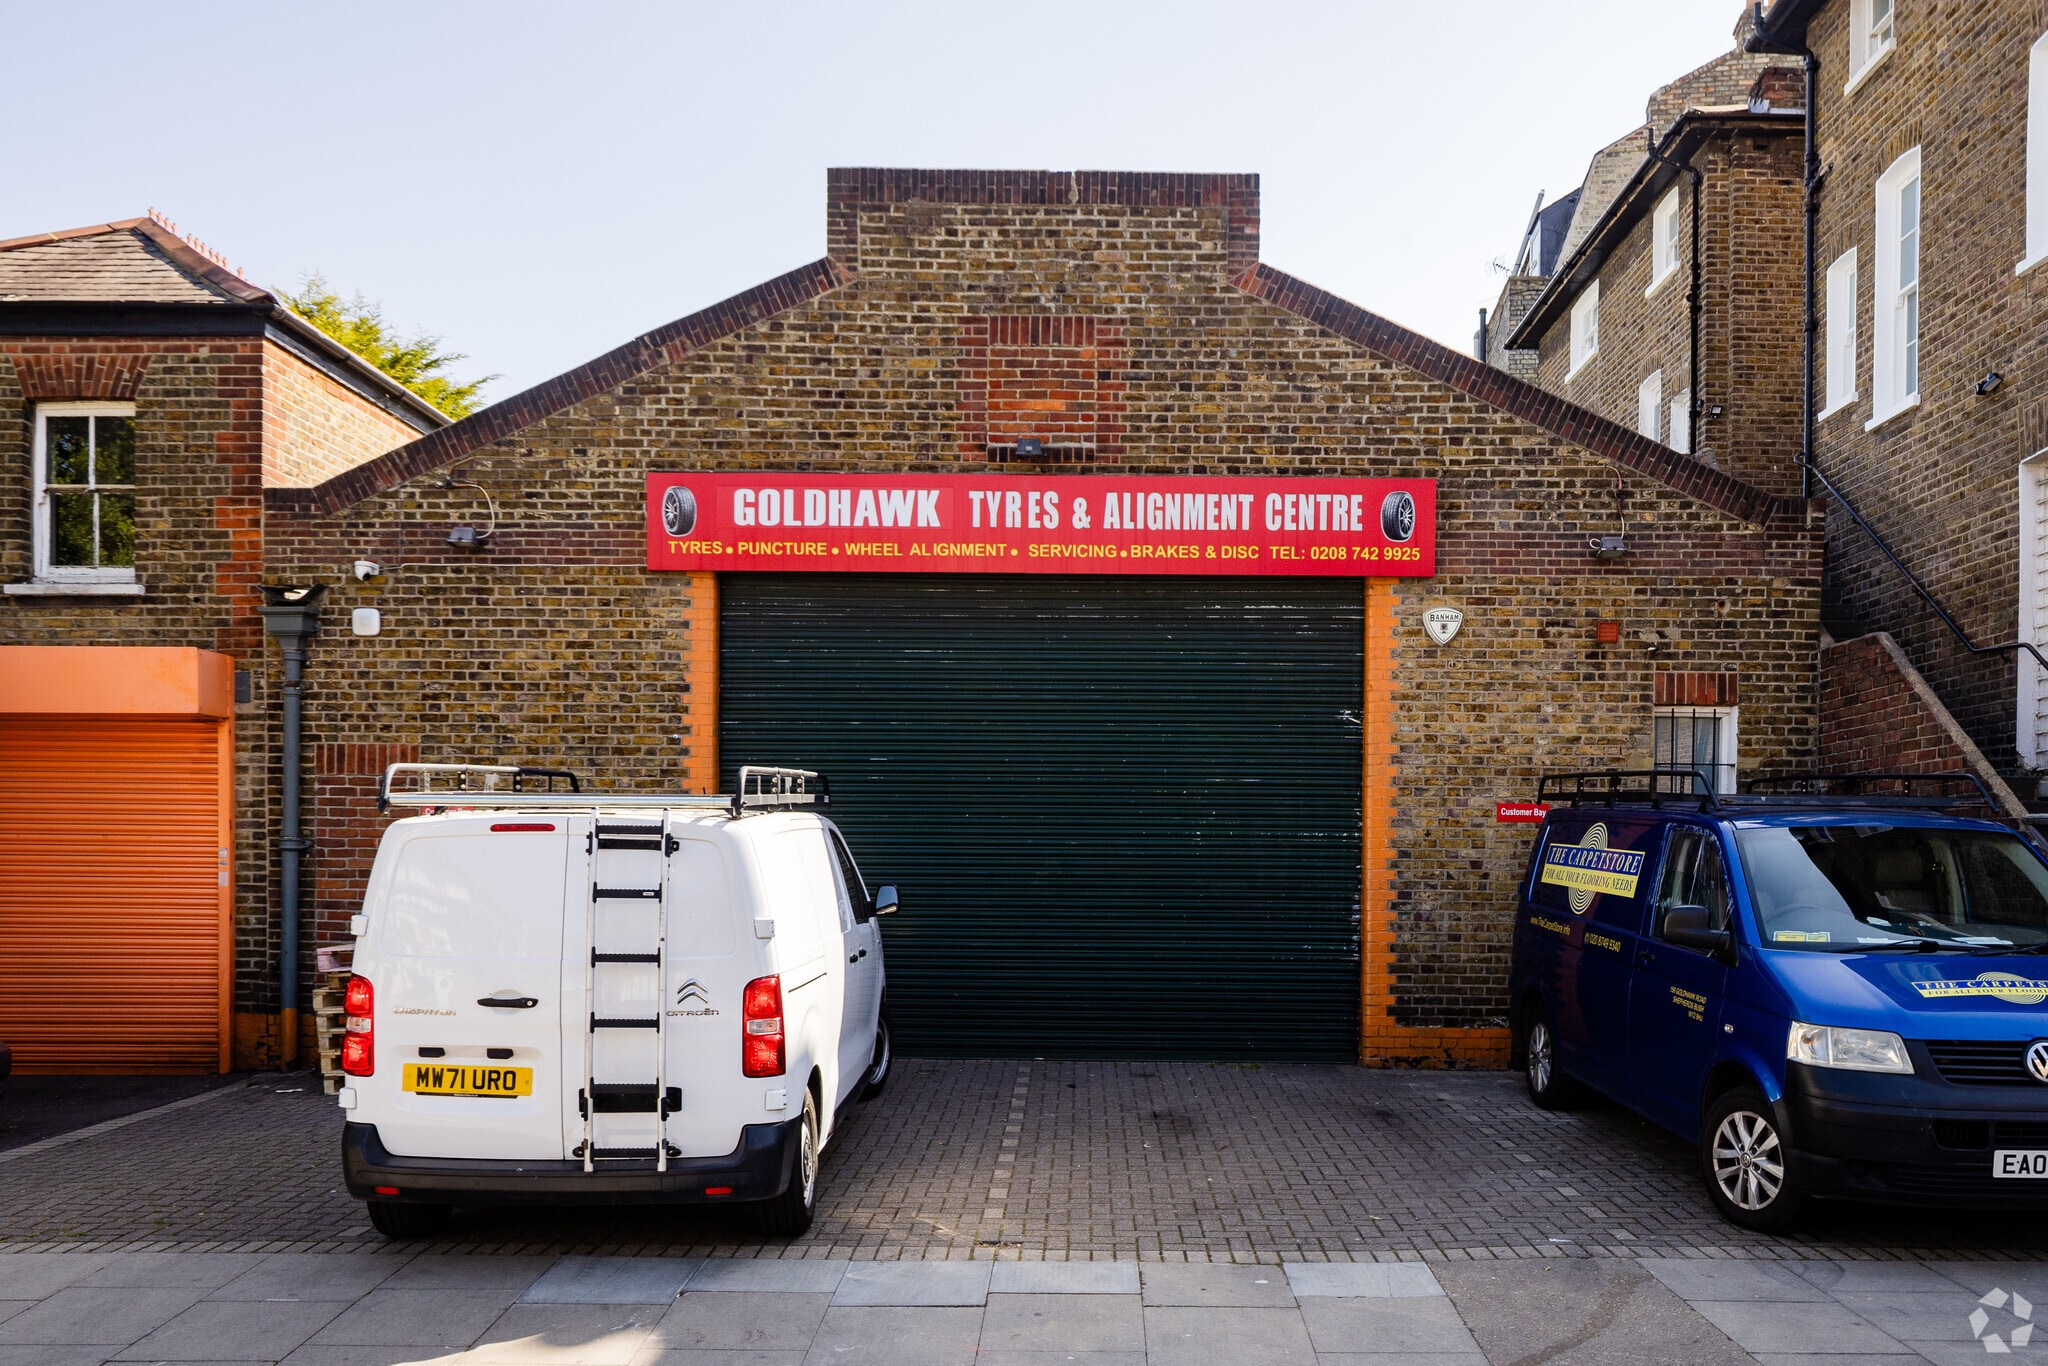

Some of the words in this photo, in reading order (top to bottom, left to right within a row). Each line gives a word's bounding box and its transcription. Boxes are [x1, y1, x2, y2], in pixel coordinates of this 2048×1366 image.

[733, 488, 941, 528] GOLDHAWK
[968, 490, 1060, 530] TYRES
[1072, 497, 1091, 529] &
[1103, 491, 1255, 531] ALIGNMENT
[1265, 492, 1363, 532] CENTRE
[668, 540, 723, 555] TYRES
[738, 541, 828, 556] PUNCTURE
[844, 542, 904, 556] WHEEL
[909, 542, 1007, 557] ALIGNMENT
[1028, 543, 1117, 558] SERVICING
[1130, 544, 1200, 559] BRAKES
[1205, 545, 1217, 559] &
[1221, 545, 1259, 559] DISC
[1269, 545, 1305, 560] TEL:
[1310, 546, 1347, 560] 0208
[1351, 546, 1379, 560] 742
[1383, 547, 1421, 561] 9925
[1500, 807, 1533, 816] Customer
[1533, 808, 1547, 818] Bay
[1549, 847, 1568, 864] THE
[1568, 849, 1641, 873] CARPETSTORE
[1544, 868, 1556, 879] FOR
[1555, 870, 1565, 880] ALL
[1580, 872, 1612, 888] FLOORING
[1611, 877, 1634, 892] NEEDS
[416, 1066, 466, 1089] MW71
[472, 1068, 517, 1091] URO
